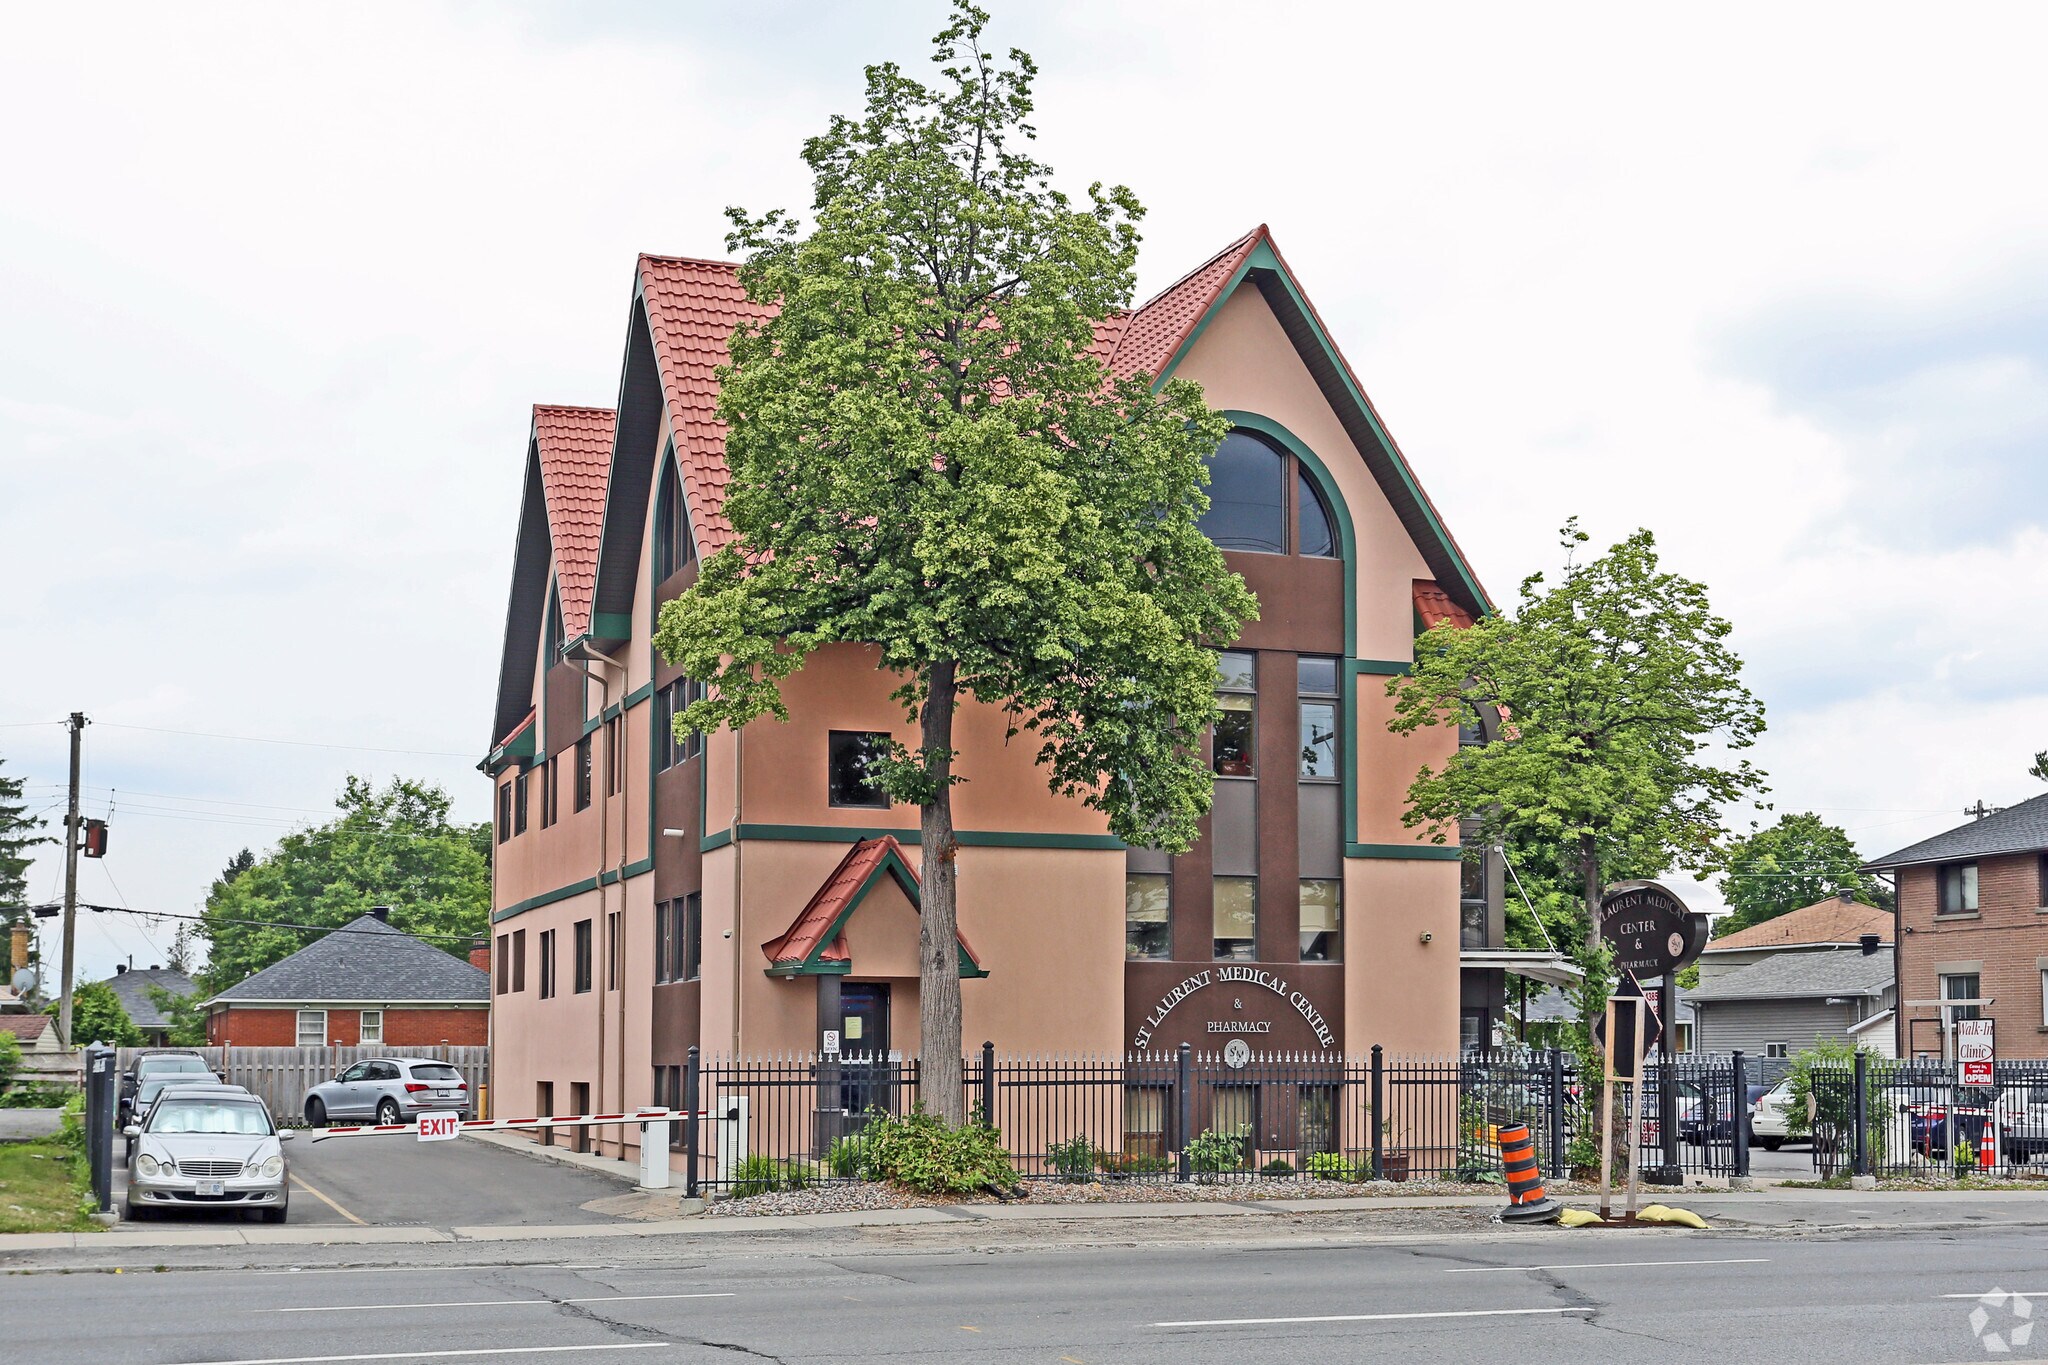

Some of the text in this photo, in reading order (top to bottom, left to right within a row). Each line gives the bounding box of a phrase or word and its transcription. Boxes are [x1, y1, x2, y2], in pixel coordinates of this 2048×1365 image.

[1602, 895, 1642, 921] LAURENT
[1647, 896, 1685, 922] MEDICAL
[1620, 920, 1656, 934] CENTER
[1635, 938, 1642, 950] &
[1620, 959, 1658, 969] PHARMACY
[1134, 966, 1335, 1050] ST LAURENT MEDICAL CENTRE
[1234, 998, 1243, 1009] &
[1206, 1021, 1271, 1033] PHARMACY
[1958, 1021, 1993, 1036] Walk-In
[1960, 1044, 1986, 1059] Clinic
[1966, 1074, 1991, 1083] OPEN
[421, 1118, 456, 1135] EXIT
